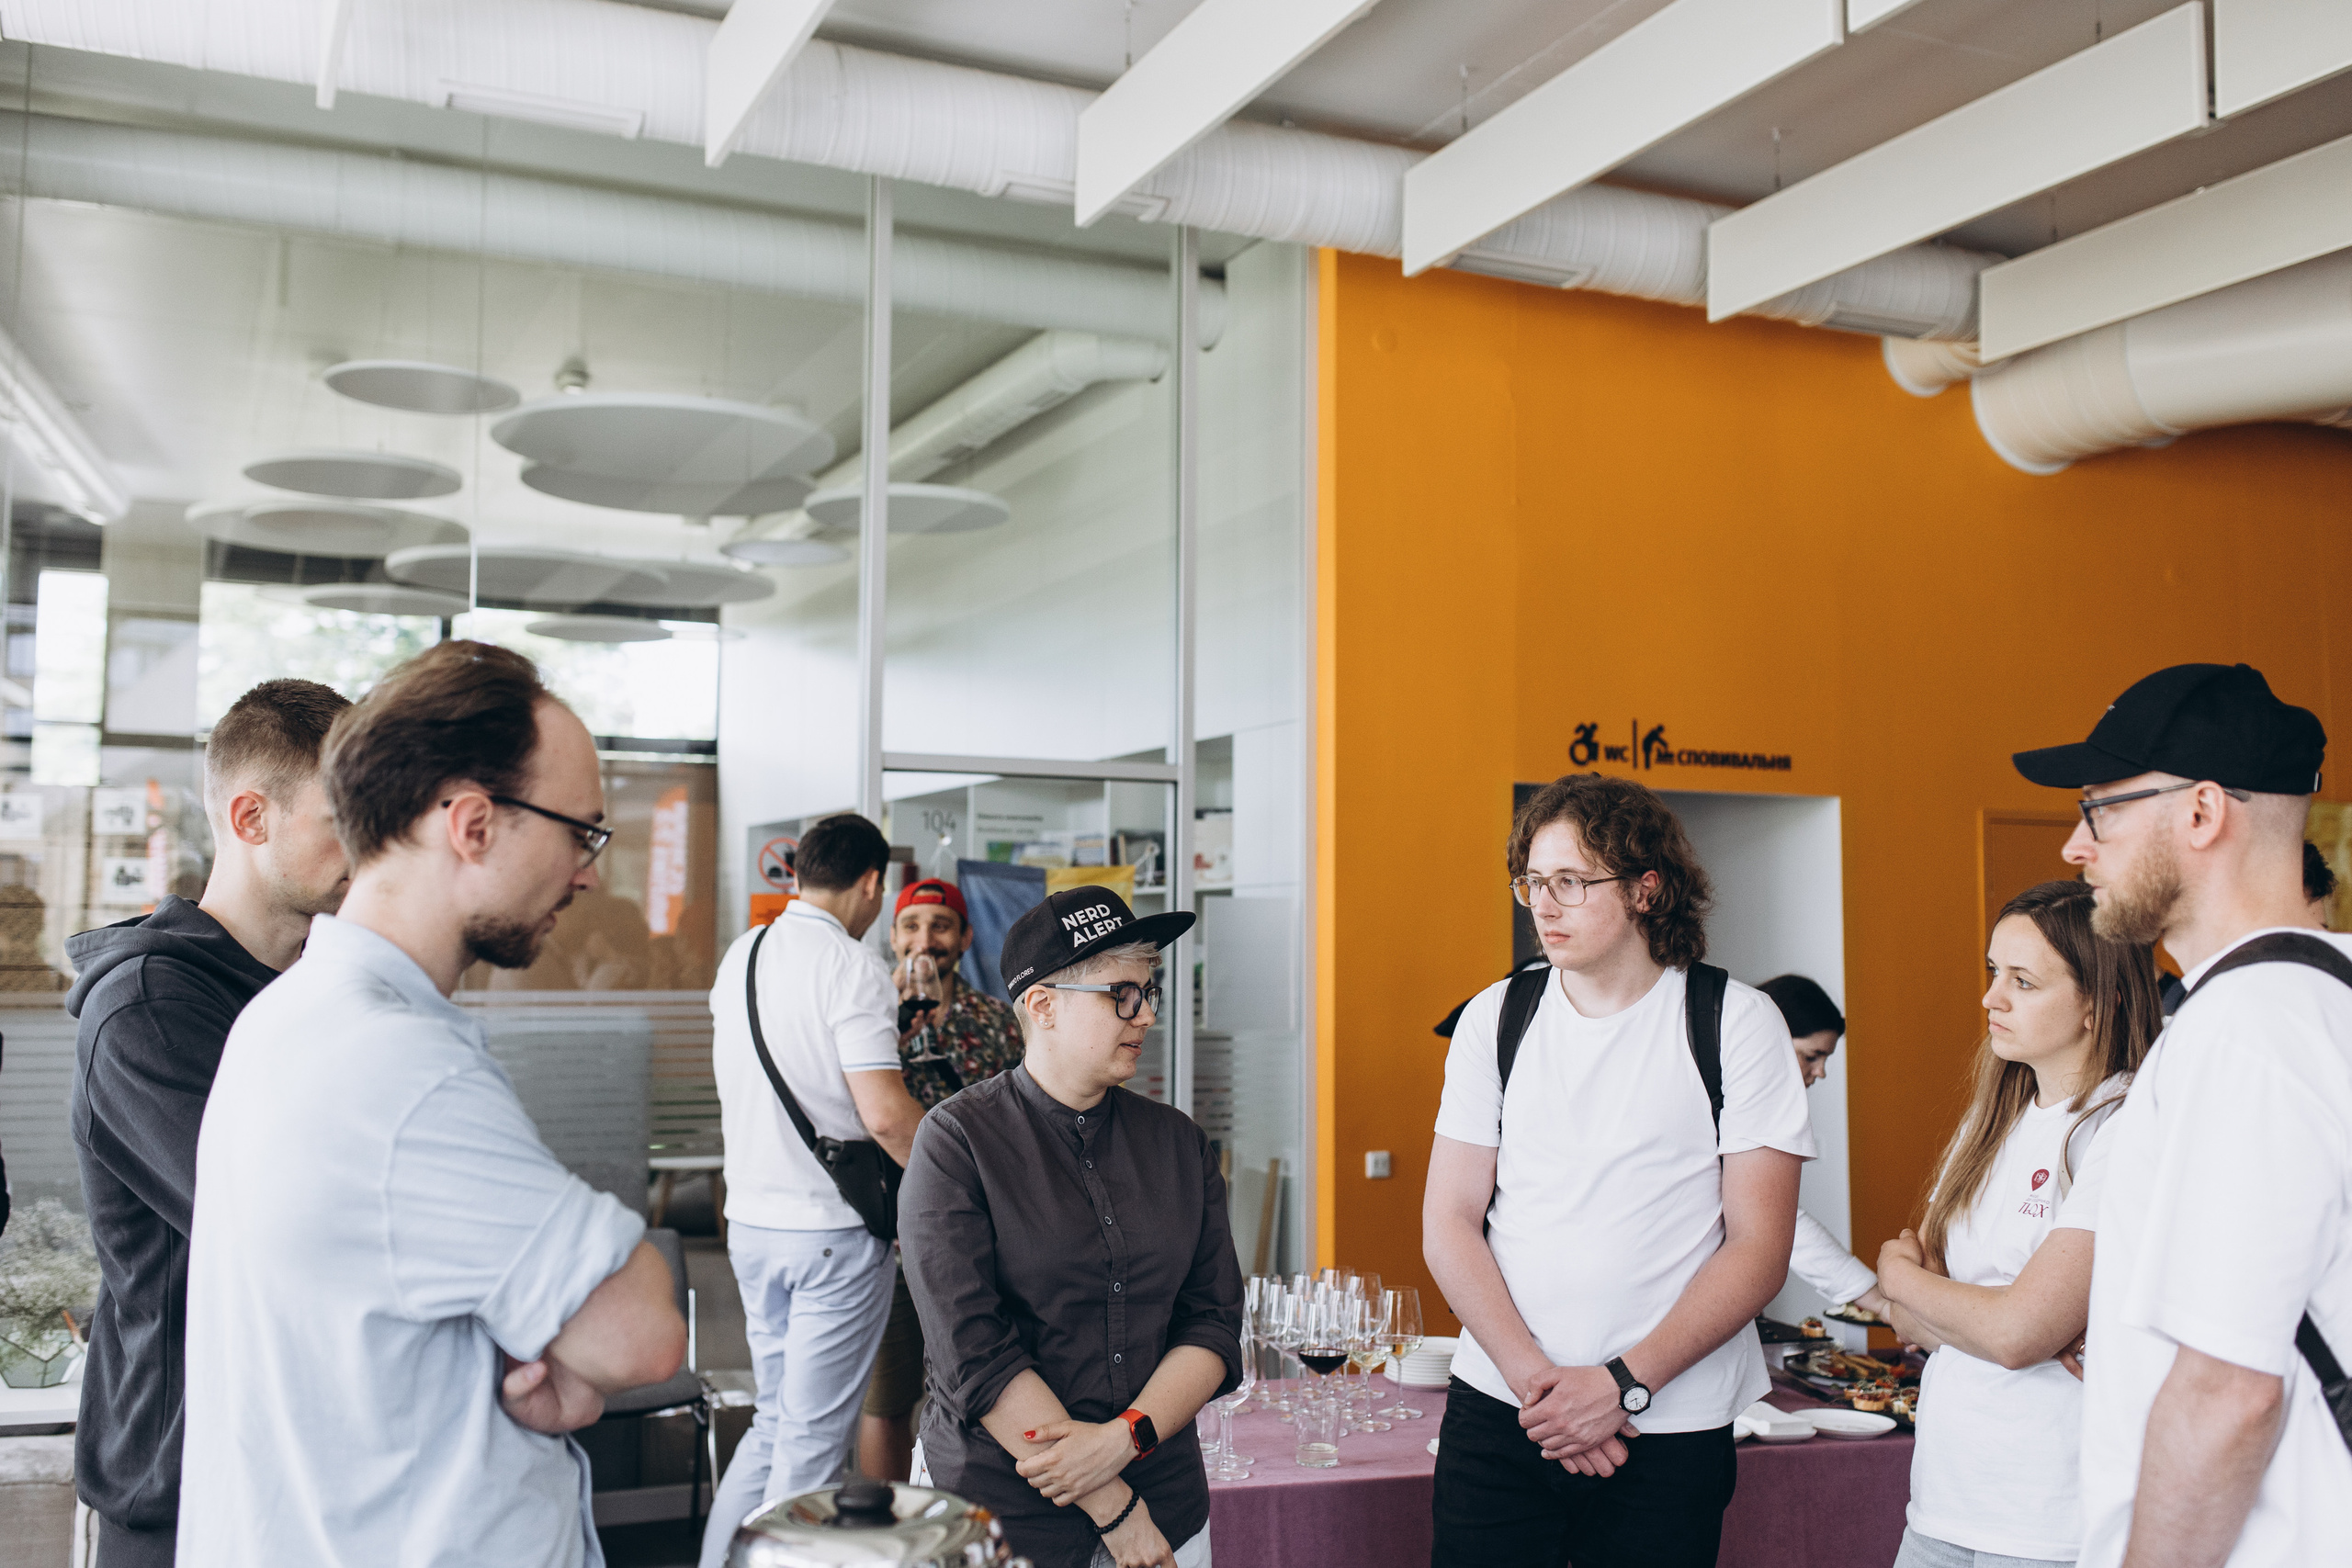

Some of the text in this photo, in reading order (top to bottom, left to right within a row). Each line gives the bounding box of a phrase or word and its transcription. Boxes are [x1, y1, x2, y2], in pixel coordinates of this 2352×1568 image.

[1604, 745, 1629, 763] WC
[1061, 904, 1111, 931] NERD
[1073, 916, 1123, 948] ALERT
